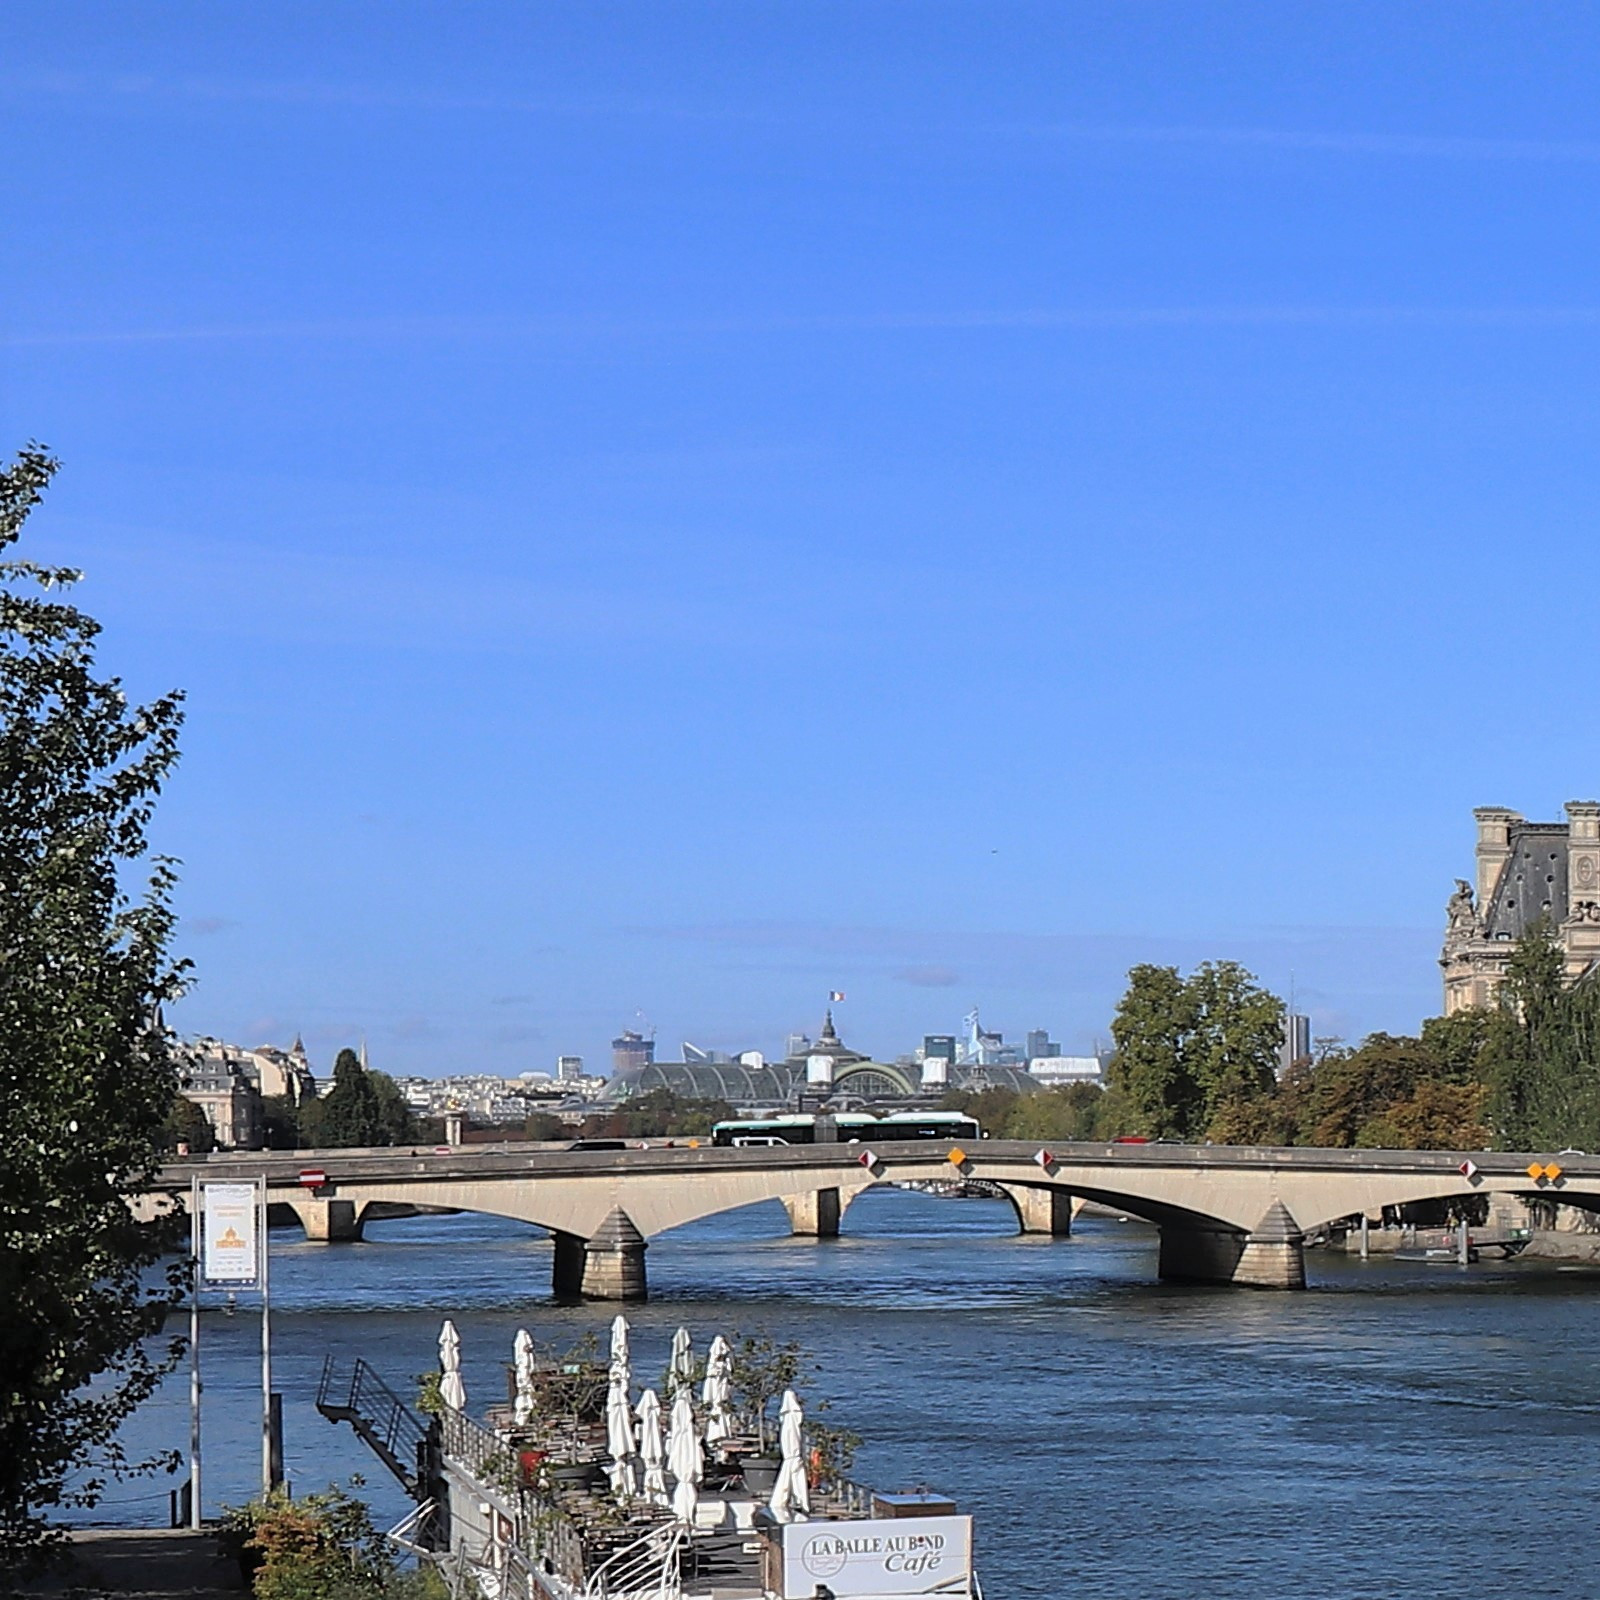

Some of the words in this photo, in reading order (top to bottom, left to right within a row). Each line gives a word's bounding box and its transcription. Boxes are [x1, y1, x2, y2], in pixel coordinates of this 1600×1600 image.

[811, 1541, 832, 1556] LA
[835, 1538, 882, 1555] BALLE
[885, 1537, 905, 1553] AU
[884, 1551, 942, 1576] Café
